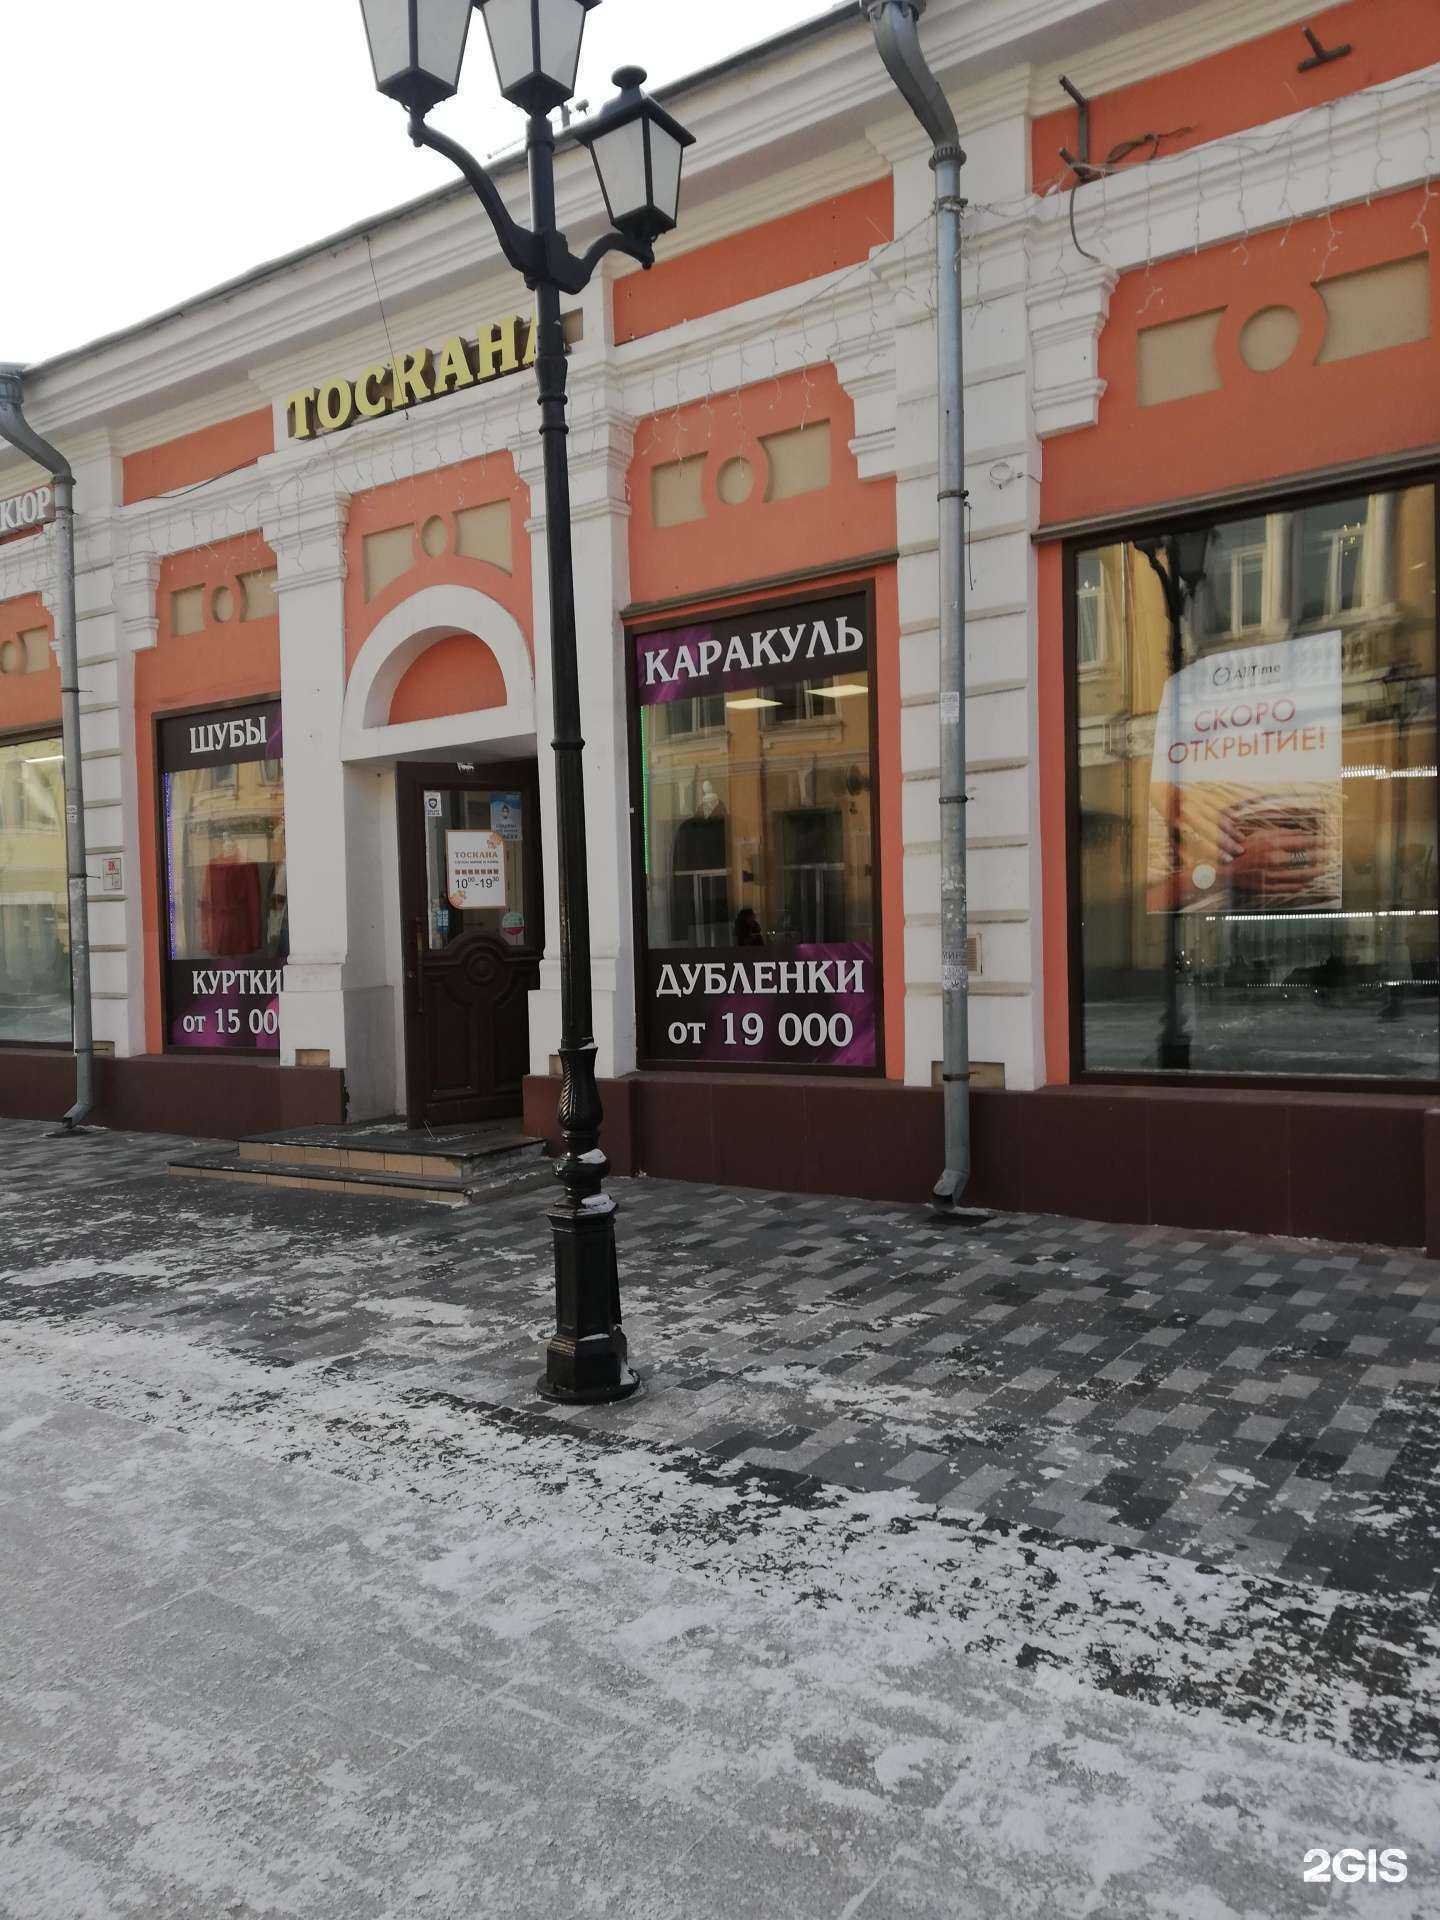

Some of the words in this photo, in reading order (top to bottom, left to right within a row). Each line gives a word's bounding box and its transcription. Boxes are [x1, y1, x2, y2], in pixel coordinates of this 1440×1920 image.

[644, 616, 863, 685] КАРАКУЛЬ
[1194, 699, 1296, 732] СКОРО
[190, 716, 267, 754] ШУБЫ
[1168, 726, 1325, 764] ОТКРЫТИЕ!
[192, 969, 282, 995] КУРТКИ
[656, 960, 865, 998] ДУБЛЕНКИ
[183, 1015, 206, 1033] от
[215, 1008, 241, 1034] 15
[248, 1008, 280, 1035] 00
[667, 1021, 706, 1044] от
[721, 1012, 764, 1046] 19
[778, 1012, 854, 1047] 000
